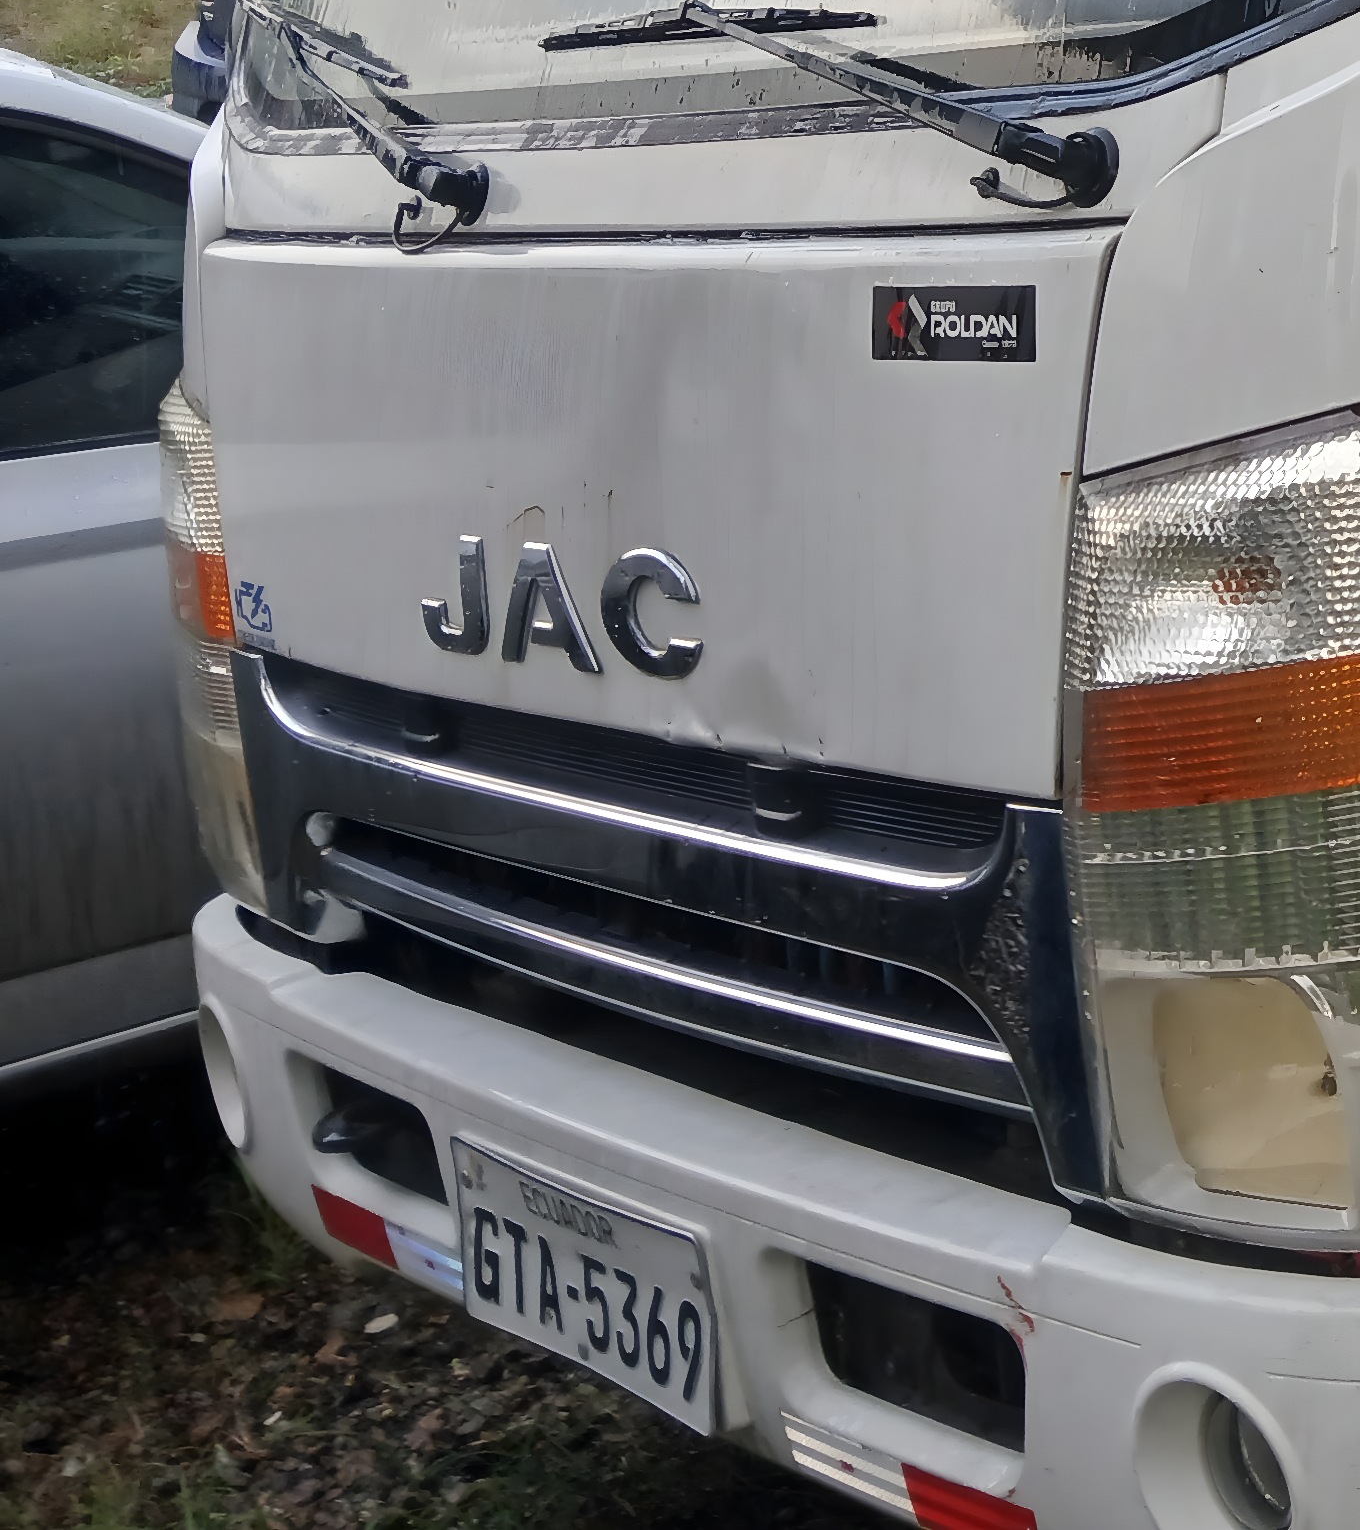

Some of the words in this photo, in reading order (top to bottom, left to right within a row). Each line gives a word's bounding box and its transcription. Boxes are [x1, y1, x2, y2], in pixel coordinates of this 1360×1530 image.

[930, 314, 1017, 337] ROLDAN
[420, 534, 704, 680] JAC
[473, 1206, 701, 1401] GTA-5369
